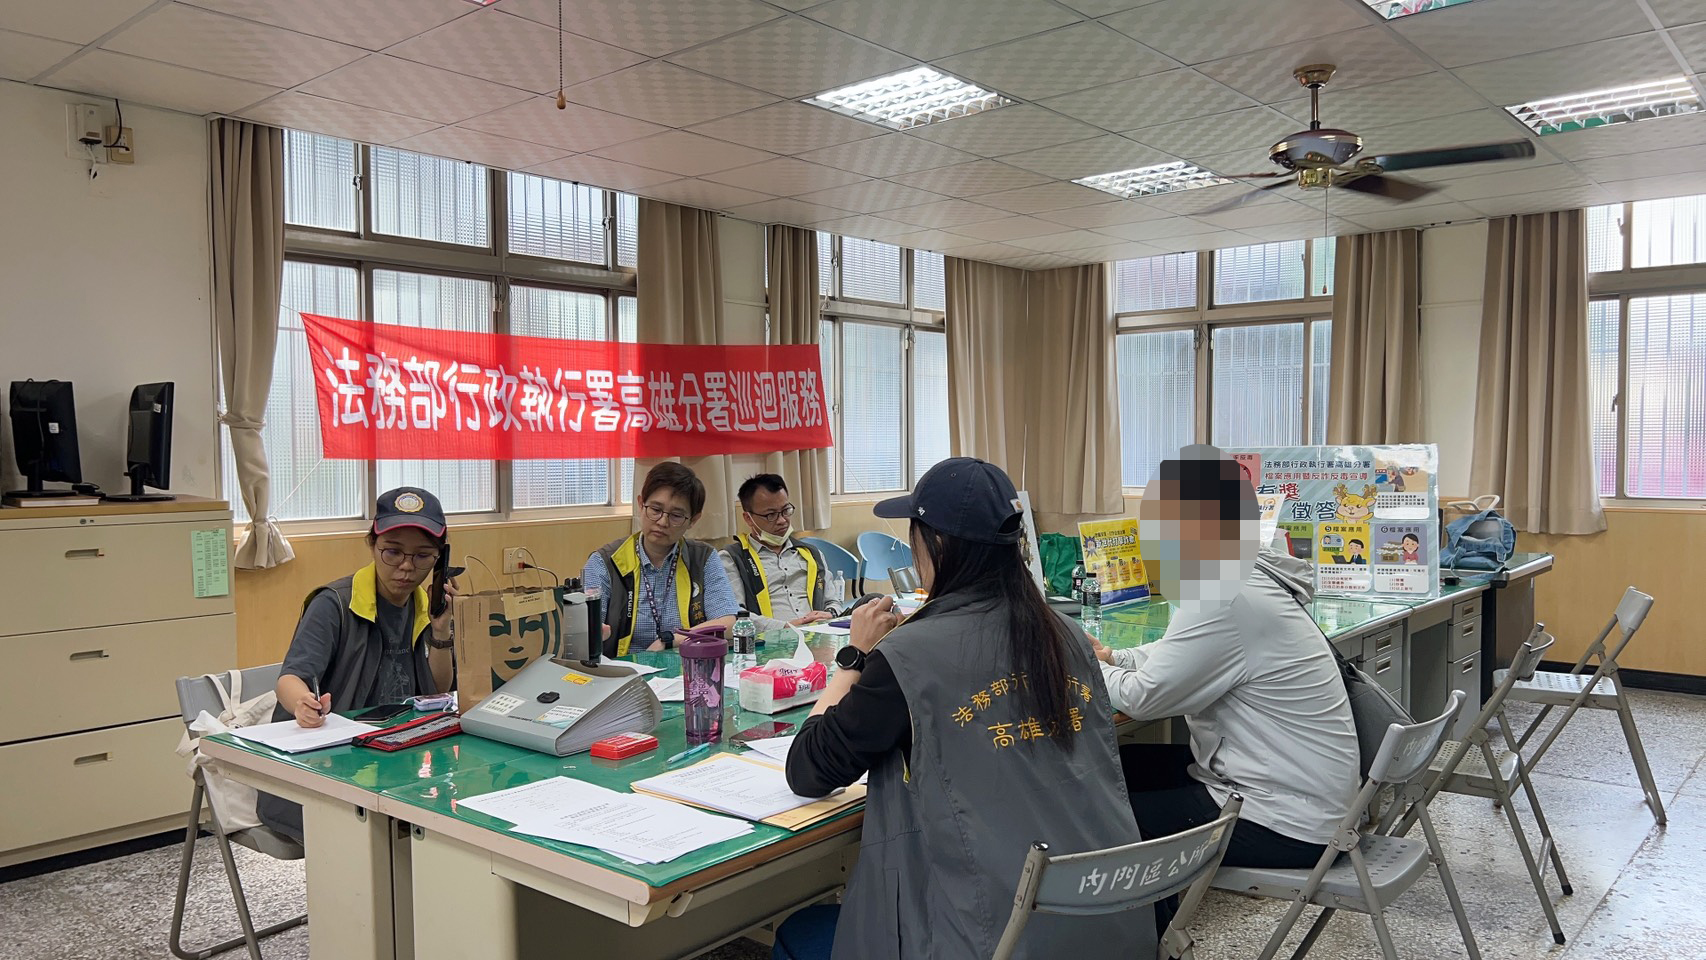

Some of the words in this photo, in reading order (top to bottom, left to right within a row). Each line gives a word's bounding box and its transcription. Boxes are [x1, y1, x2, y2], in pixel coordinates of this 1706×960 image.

[325, 346, 823, 434] 法務部行政執行署高雄分署巡迴服務
[1264, 460, 1371, 469] 法務部行政執行署高雄分署
[1292, 501, 1337, 521] 徵答
[951, 671, 1093, 728] 法務部行行署
